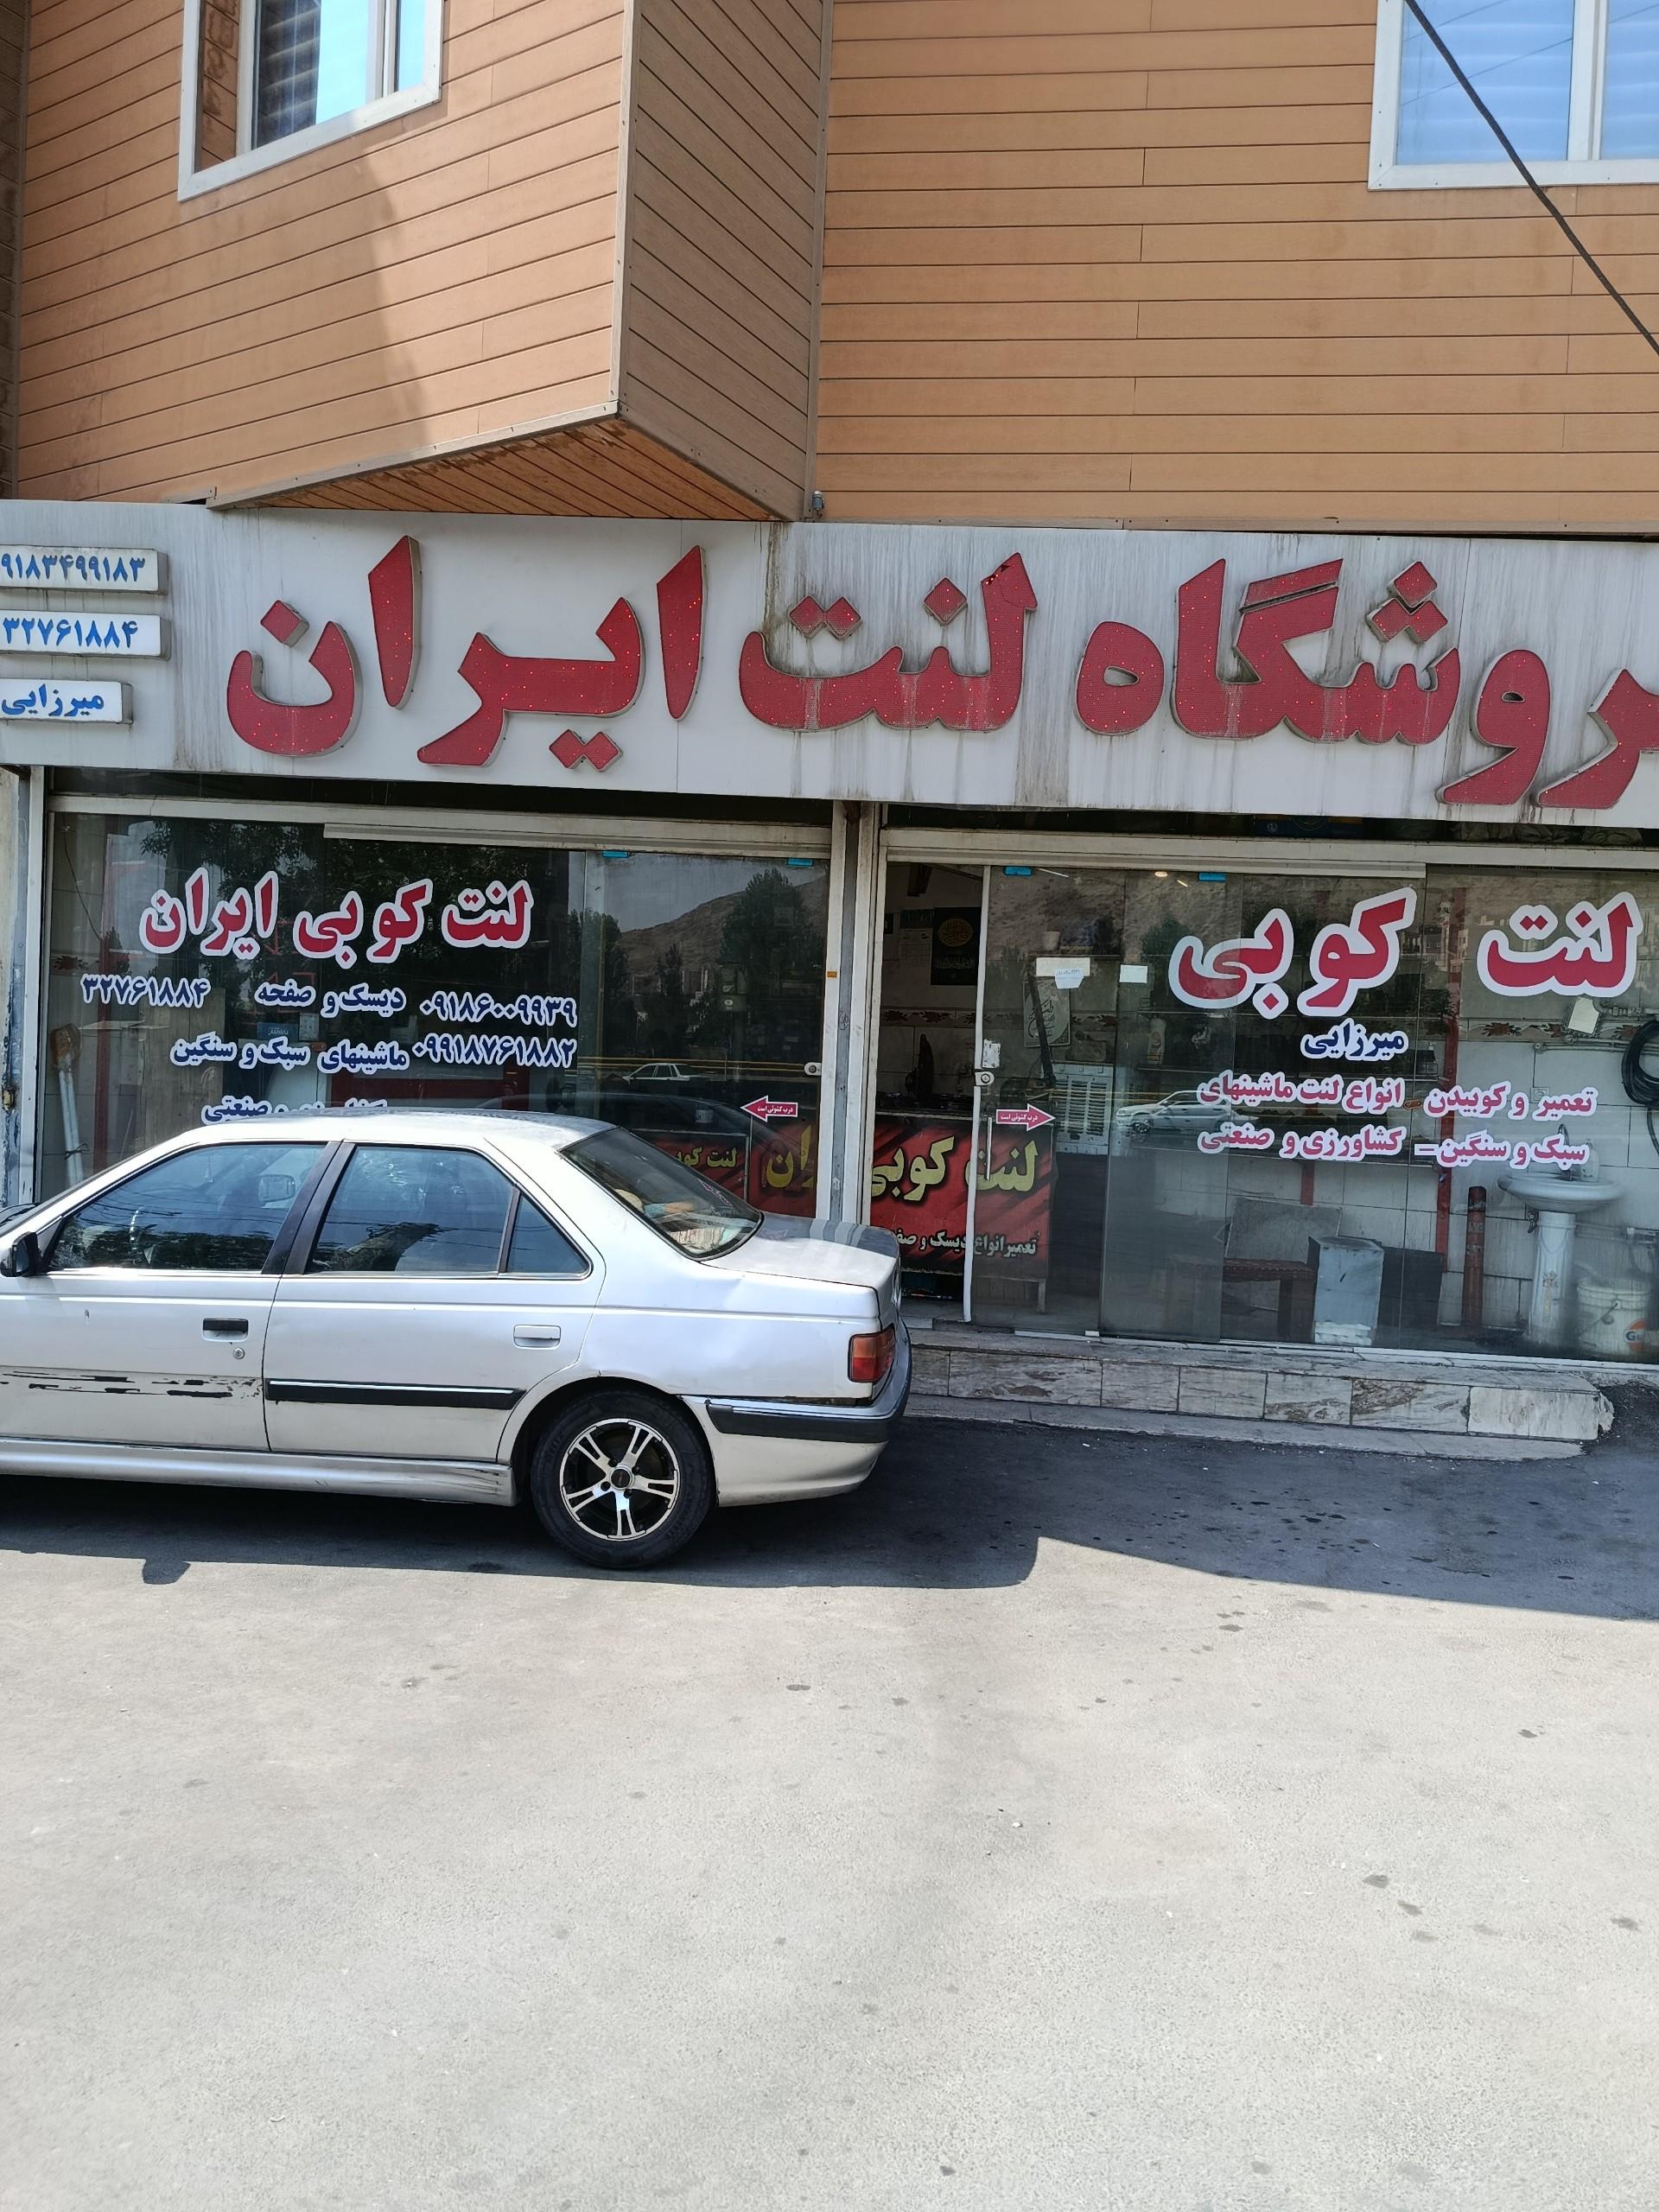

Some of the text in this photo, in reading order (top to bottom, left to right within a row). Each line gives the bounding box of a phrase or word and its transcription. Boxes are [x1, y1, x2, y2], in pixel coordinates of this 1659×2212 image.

[3, 617, 138, 648] ۳۲۷۶۱۸۸۴
[226, 534, 1659, 810] روشگاه لنت ایران
[1, 683, 105, 717] میرزایی
[143, 870, 276, 956] ایران
[445, 881, 531, 946] لنت
[1482, 897, 1638, 993] لنت
[82, 975, 209, 1007] ۳۲۷۶۱۸۸۴
[257, 980, 405, 1014] دیسک و صفحه
[172, 1033, 408, 1072] ماشینهای سبک و سنگین
[1303, 1020, 1406, 1058] میرزایی
[203, 1097, 270, 1122] صنعتی
[1198, 1072, 1596, 1119] تعمیر و کوبیدن انواع لنت ماشینهای
[1199, 1124, 1272, 1152] صنعتی
[1281, 1133, 1297, 1156] و
[1300, 1127, 1404, 1160] کشاورزی
[1440, 1132, 1509, 1165] سنگین
[1533, 1136, 1587, 1168] سبک
[707, 1147, 738, 1168] لنت
[964, 1140, 1038, 1192] لنت
[1512, 1144, 1529, 1167] و
[919, 1236, 926, 1250] و
[975, 1234, 1004, 1256] انواع
[1006, 1237, 1037, 1257] تعمیر
